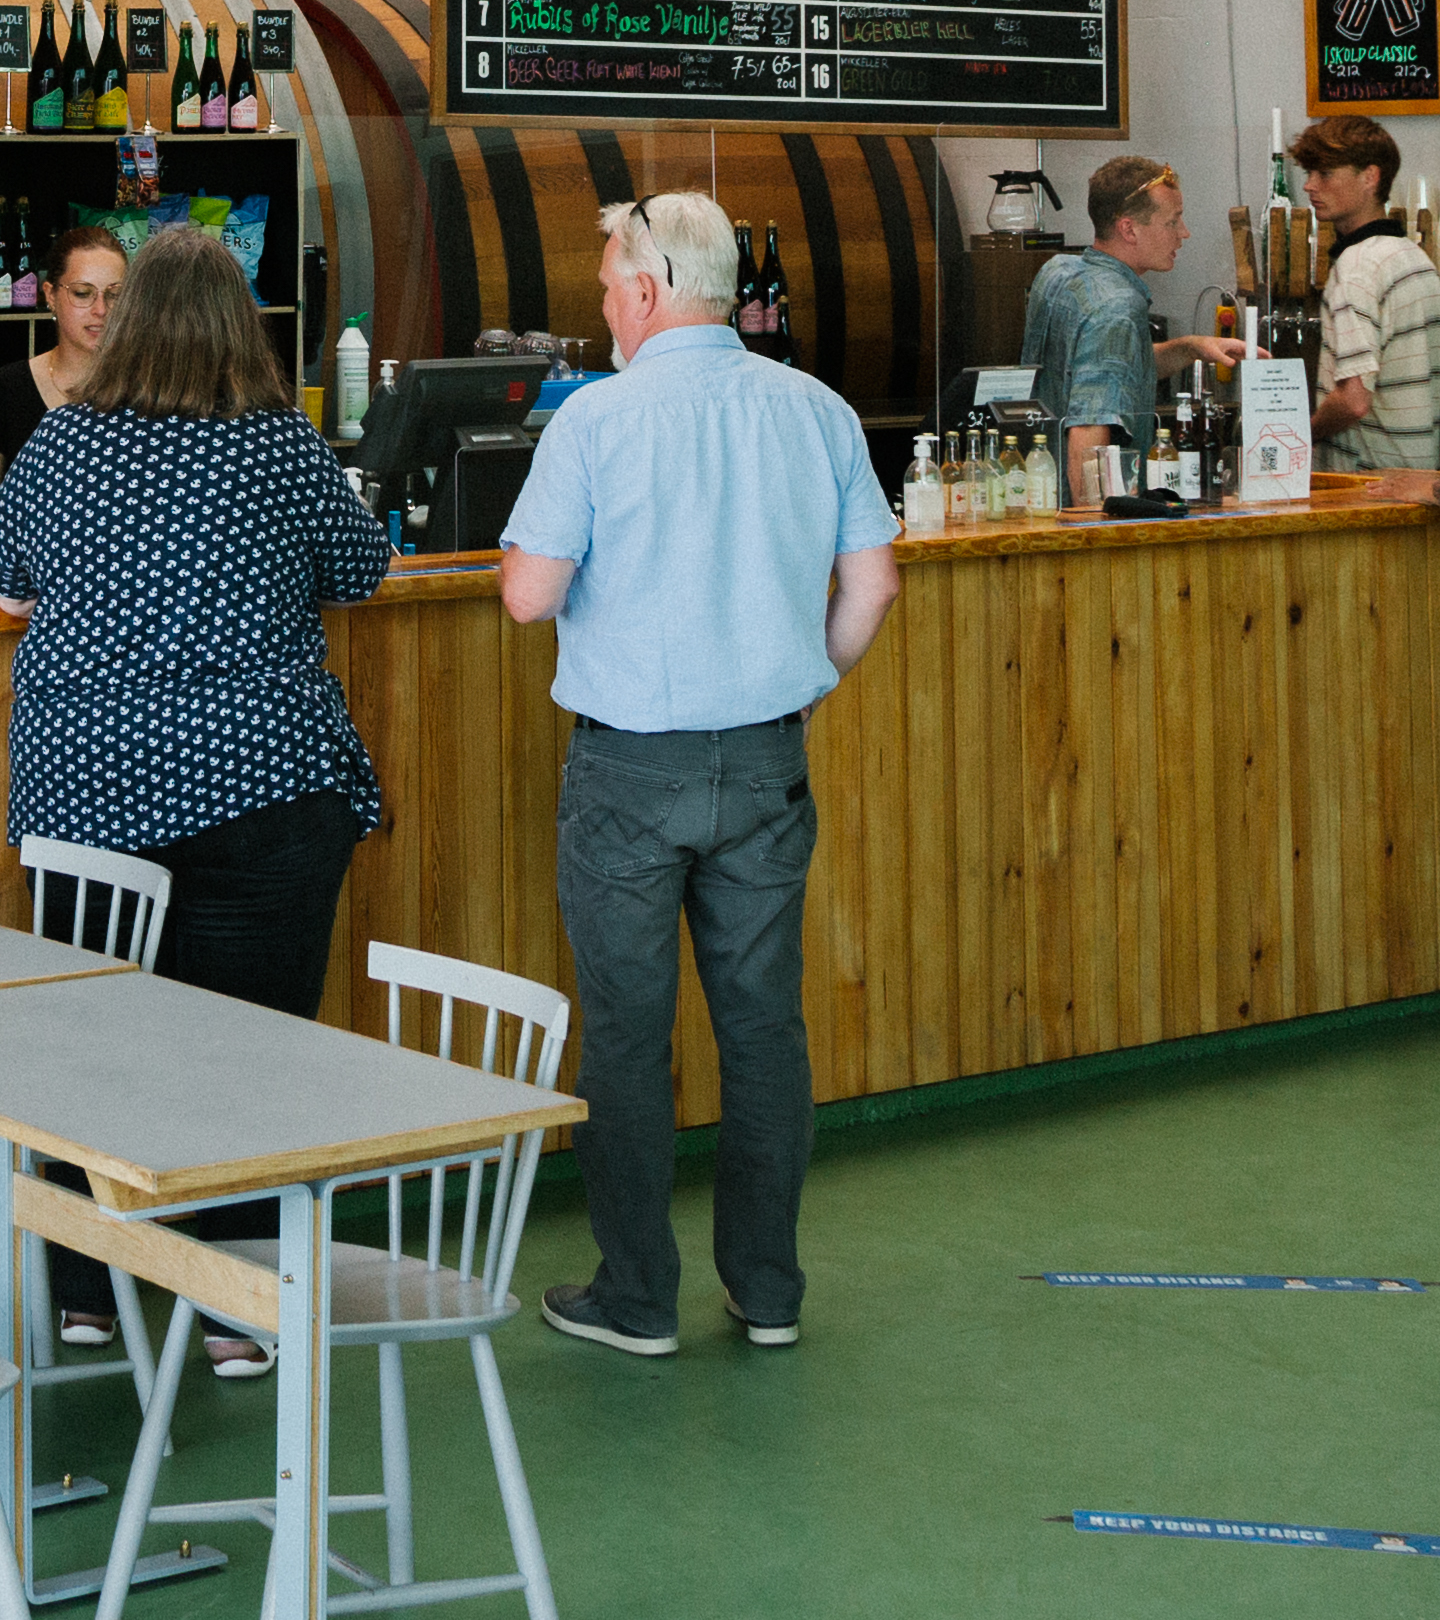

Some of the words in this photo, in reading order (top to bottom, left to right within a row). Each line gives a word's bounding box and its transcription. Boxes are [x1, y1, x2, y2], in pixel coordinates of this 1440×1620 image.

[132, 14, 161, 25] BUNDLE
[257, 15, 289, 26] BUNDLE
[479, 0, 489, 26] 7
[508, 0, 573, 34] Rubus
[581, 2, 599, 33] of
[604, 1, 652, 40] Rose
[655, 3, 729, 46] Vanilje
[770, 5, 797, 31] 55
[811, 14, 829, 40] 15
[936, 22, 975, 41] HELL
[478, 51, 489, 77] 8
[1324, 45, 1367, 65] ISKOLD
[1368, 45, 1417, 62] CLASSIC
[508, 59, 543, 84] BEER
[546, 57, 583, 82] GEEK
[811, 63, 830, 88] 16
[1336, 64, 1361, 77] 212
[1394, 64, 1417, 77] 212
[1055, 1274, 1101, 1284] KEEP
[1105, 1275, 1156, 1285] YOUR
[1158, 1277, 1246, 1286] DISTANCE
[1089, 1515, 1145, 1531] KEEP
[1151, 1519, 1211, 1534] YOUR
[1216, 1523, 1328, 1543] DISTANCE
